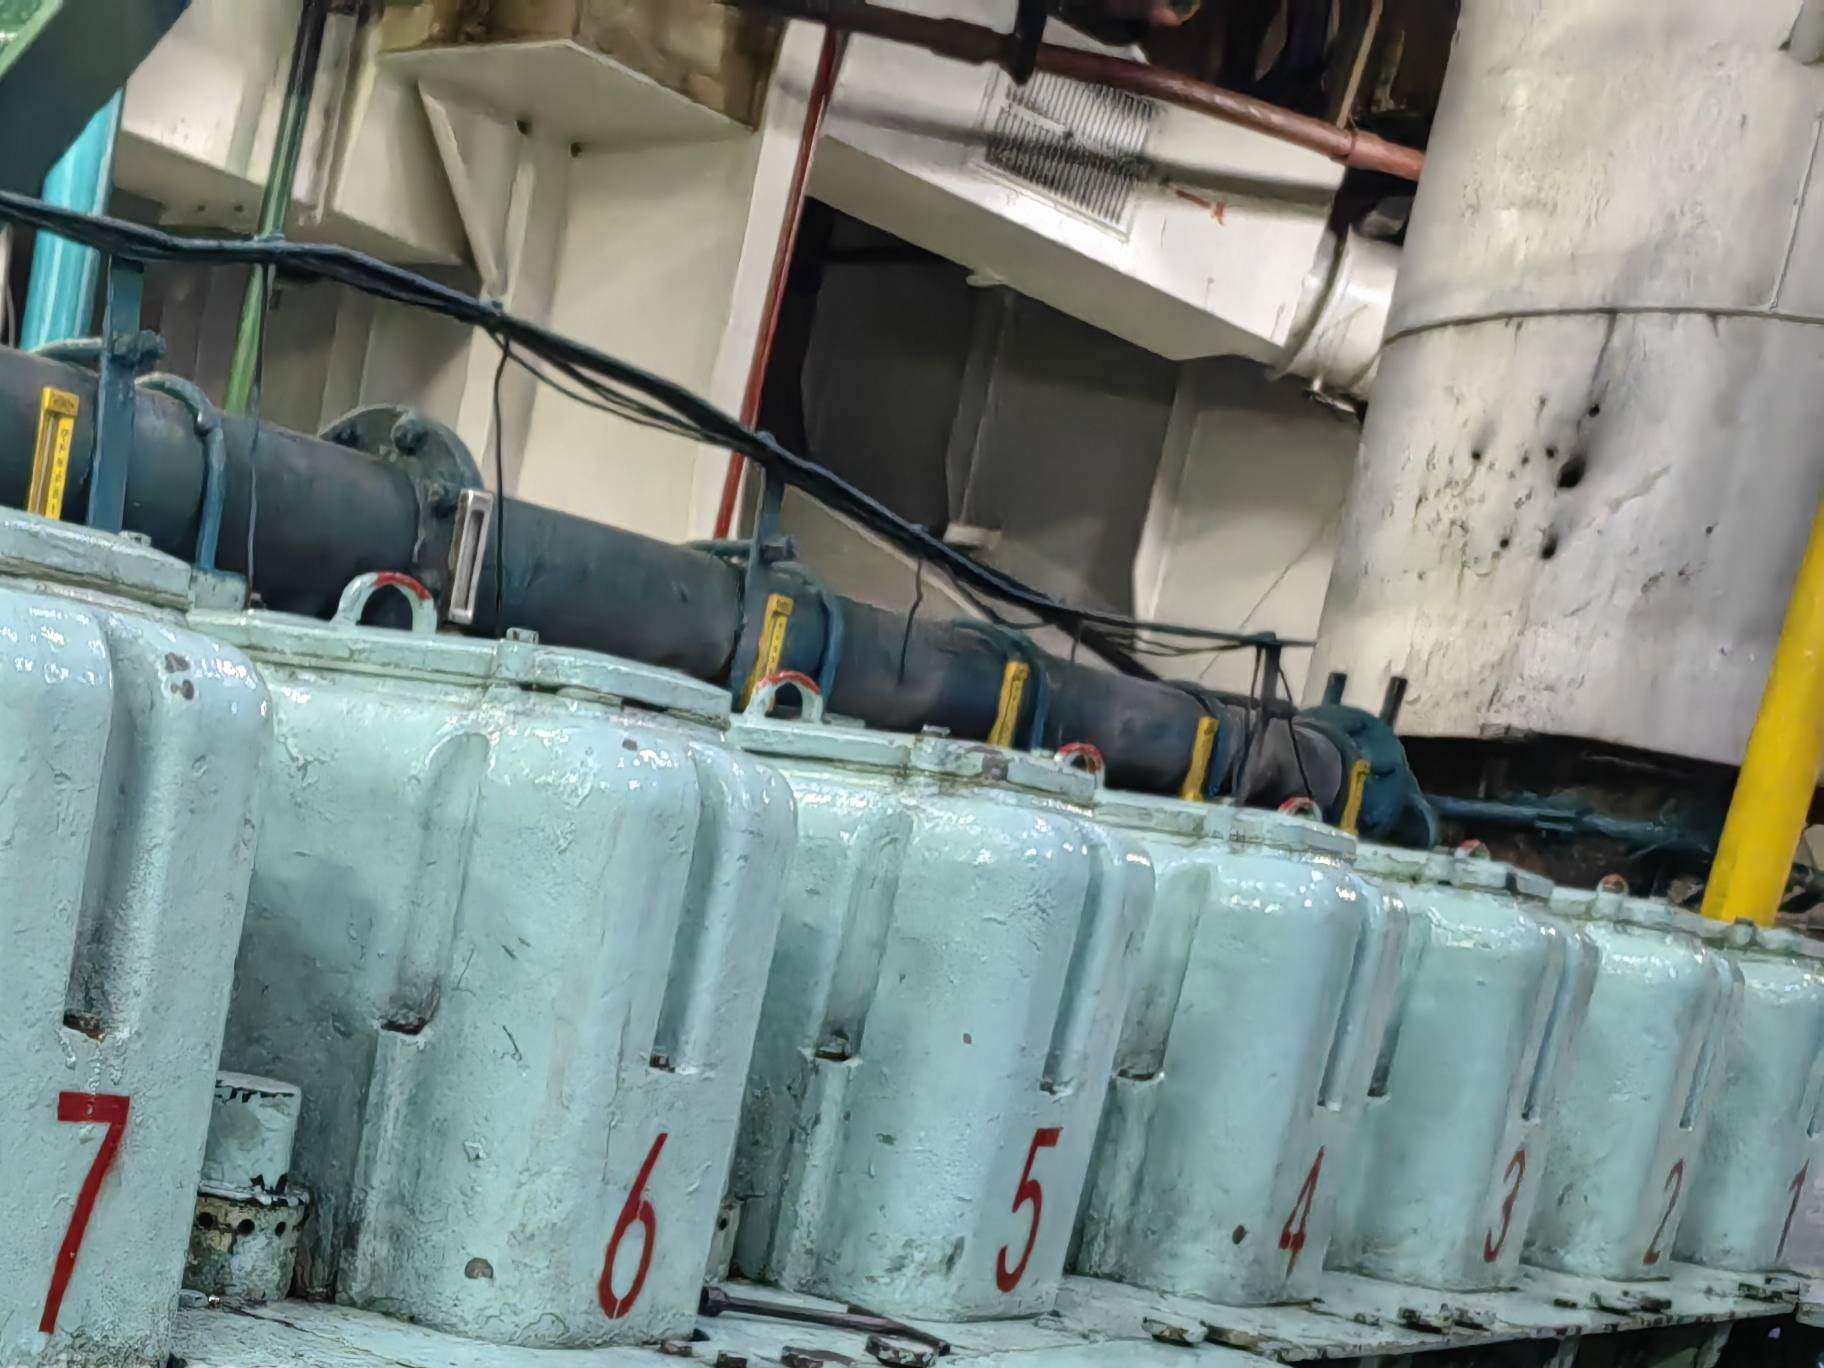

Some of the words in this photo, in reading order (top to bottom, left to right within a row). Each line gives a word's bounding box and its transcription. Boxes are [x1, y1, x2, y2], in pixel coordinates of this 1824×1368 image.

[39, 1091, 130, 1334] 7
[598, 1132, 668, 1320] 6
[996, 1127, 1062, 1292] 5
[1278, 1144, 1327, 1281] 4
[1483, 1148, 1527, 1264] 3
[1642, 1158, 1685, 1266] 2
[1776, 1158, 1810, 1264] 1
